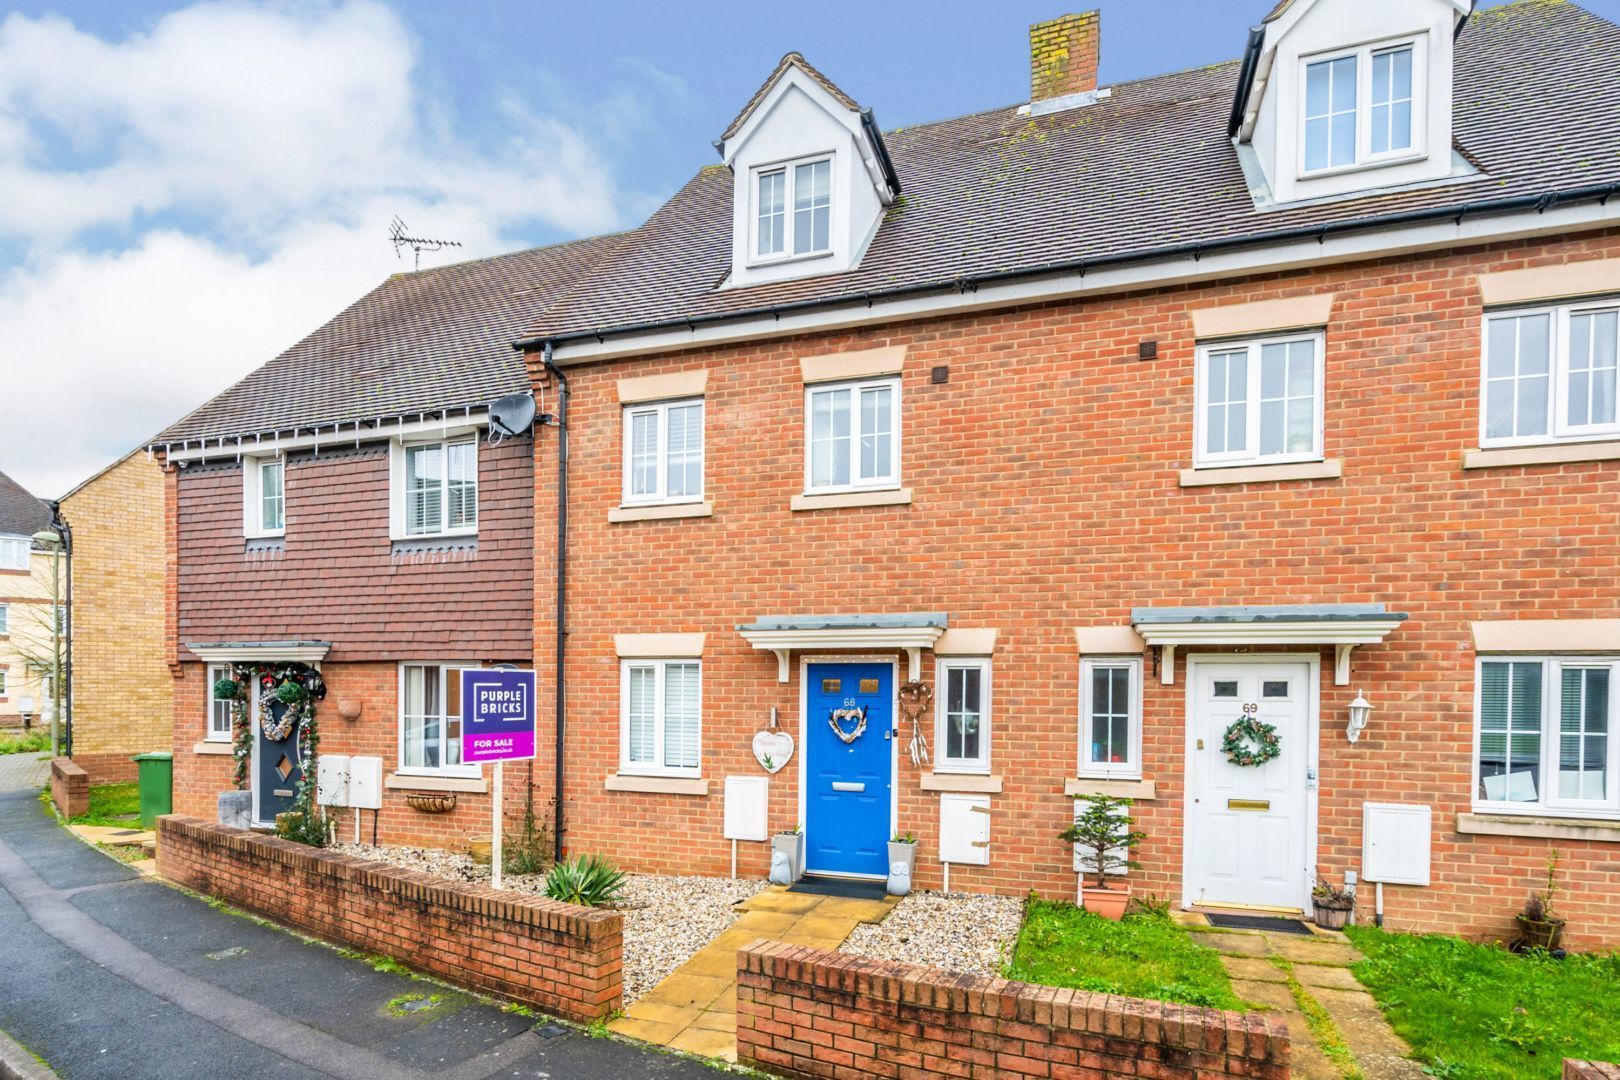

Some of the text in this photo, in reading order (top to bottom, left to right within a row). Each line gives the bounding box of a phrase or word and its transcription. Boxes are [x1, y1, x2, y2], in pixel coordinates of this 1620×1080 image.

[481, 691, 521, 701] PURPLE
[844, 698, 856, 706] 68
[481, 703, 521, 713] BRICKS
[1243, 703, 1258, 713] 69
[474, 738, 513, 748] FOR SALE
